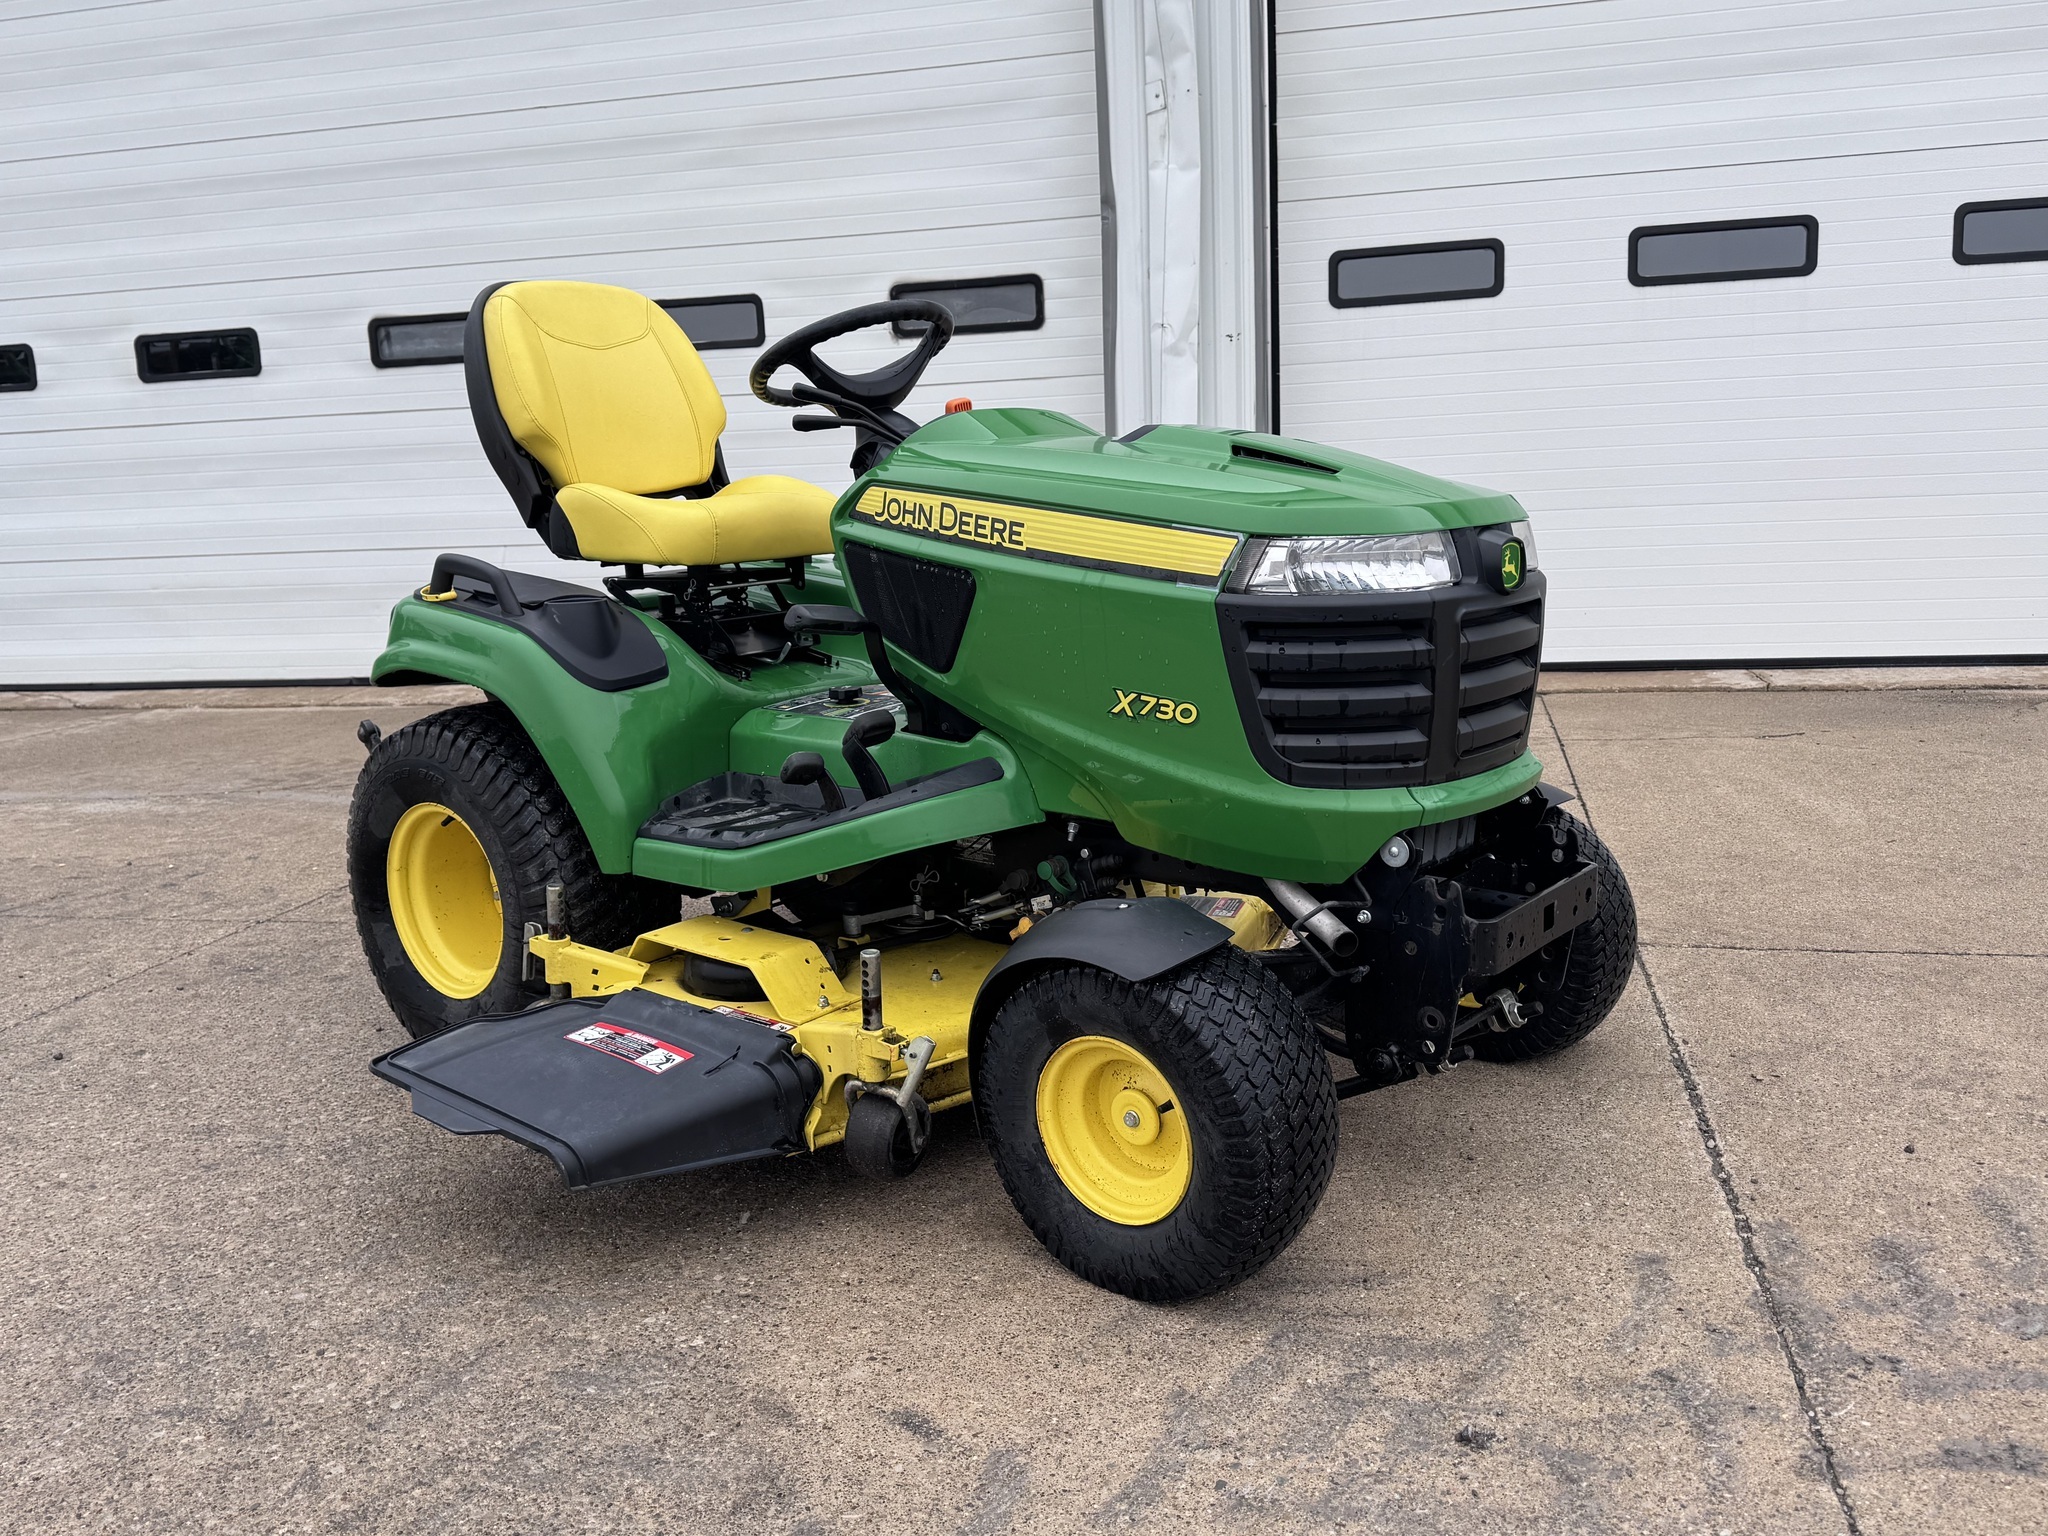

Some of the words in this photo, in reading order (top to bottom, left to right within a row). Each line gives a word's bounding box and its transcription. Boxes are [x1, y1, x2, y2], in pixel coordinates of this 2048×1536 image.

[874, 490, 934, 529] JOHN
[938, 501, 1026, 547] DEERE
[1109, 689, 1198, 724] X730
